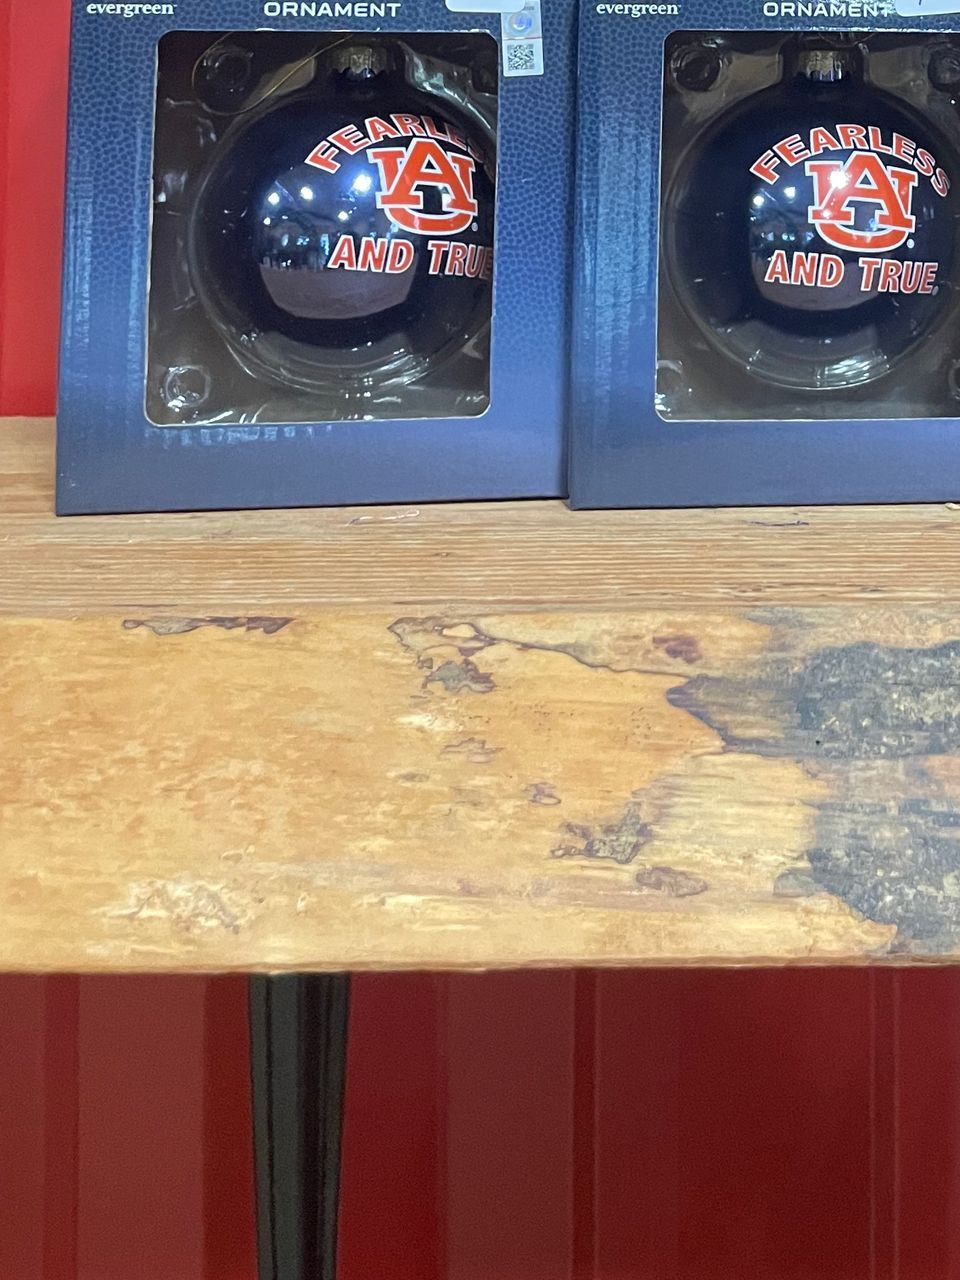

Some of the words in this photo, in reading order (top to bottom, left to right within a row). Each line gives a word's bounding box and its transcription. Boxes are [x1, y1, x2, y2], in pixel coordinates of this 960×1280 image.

[85, 3, 175, 17] evergreen
[264, 1, 402, 18] ORNAMENT
[596, 3, 680, 17] evergreen
[763, 1, 890, 18] ORNAMENT
[749, 123, 951, 197] FEARLESS
[327, 234, 415, 274] AND
[764, 249, 845, 288] AND
[858, 256, 939, 295] TRUE
